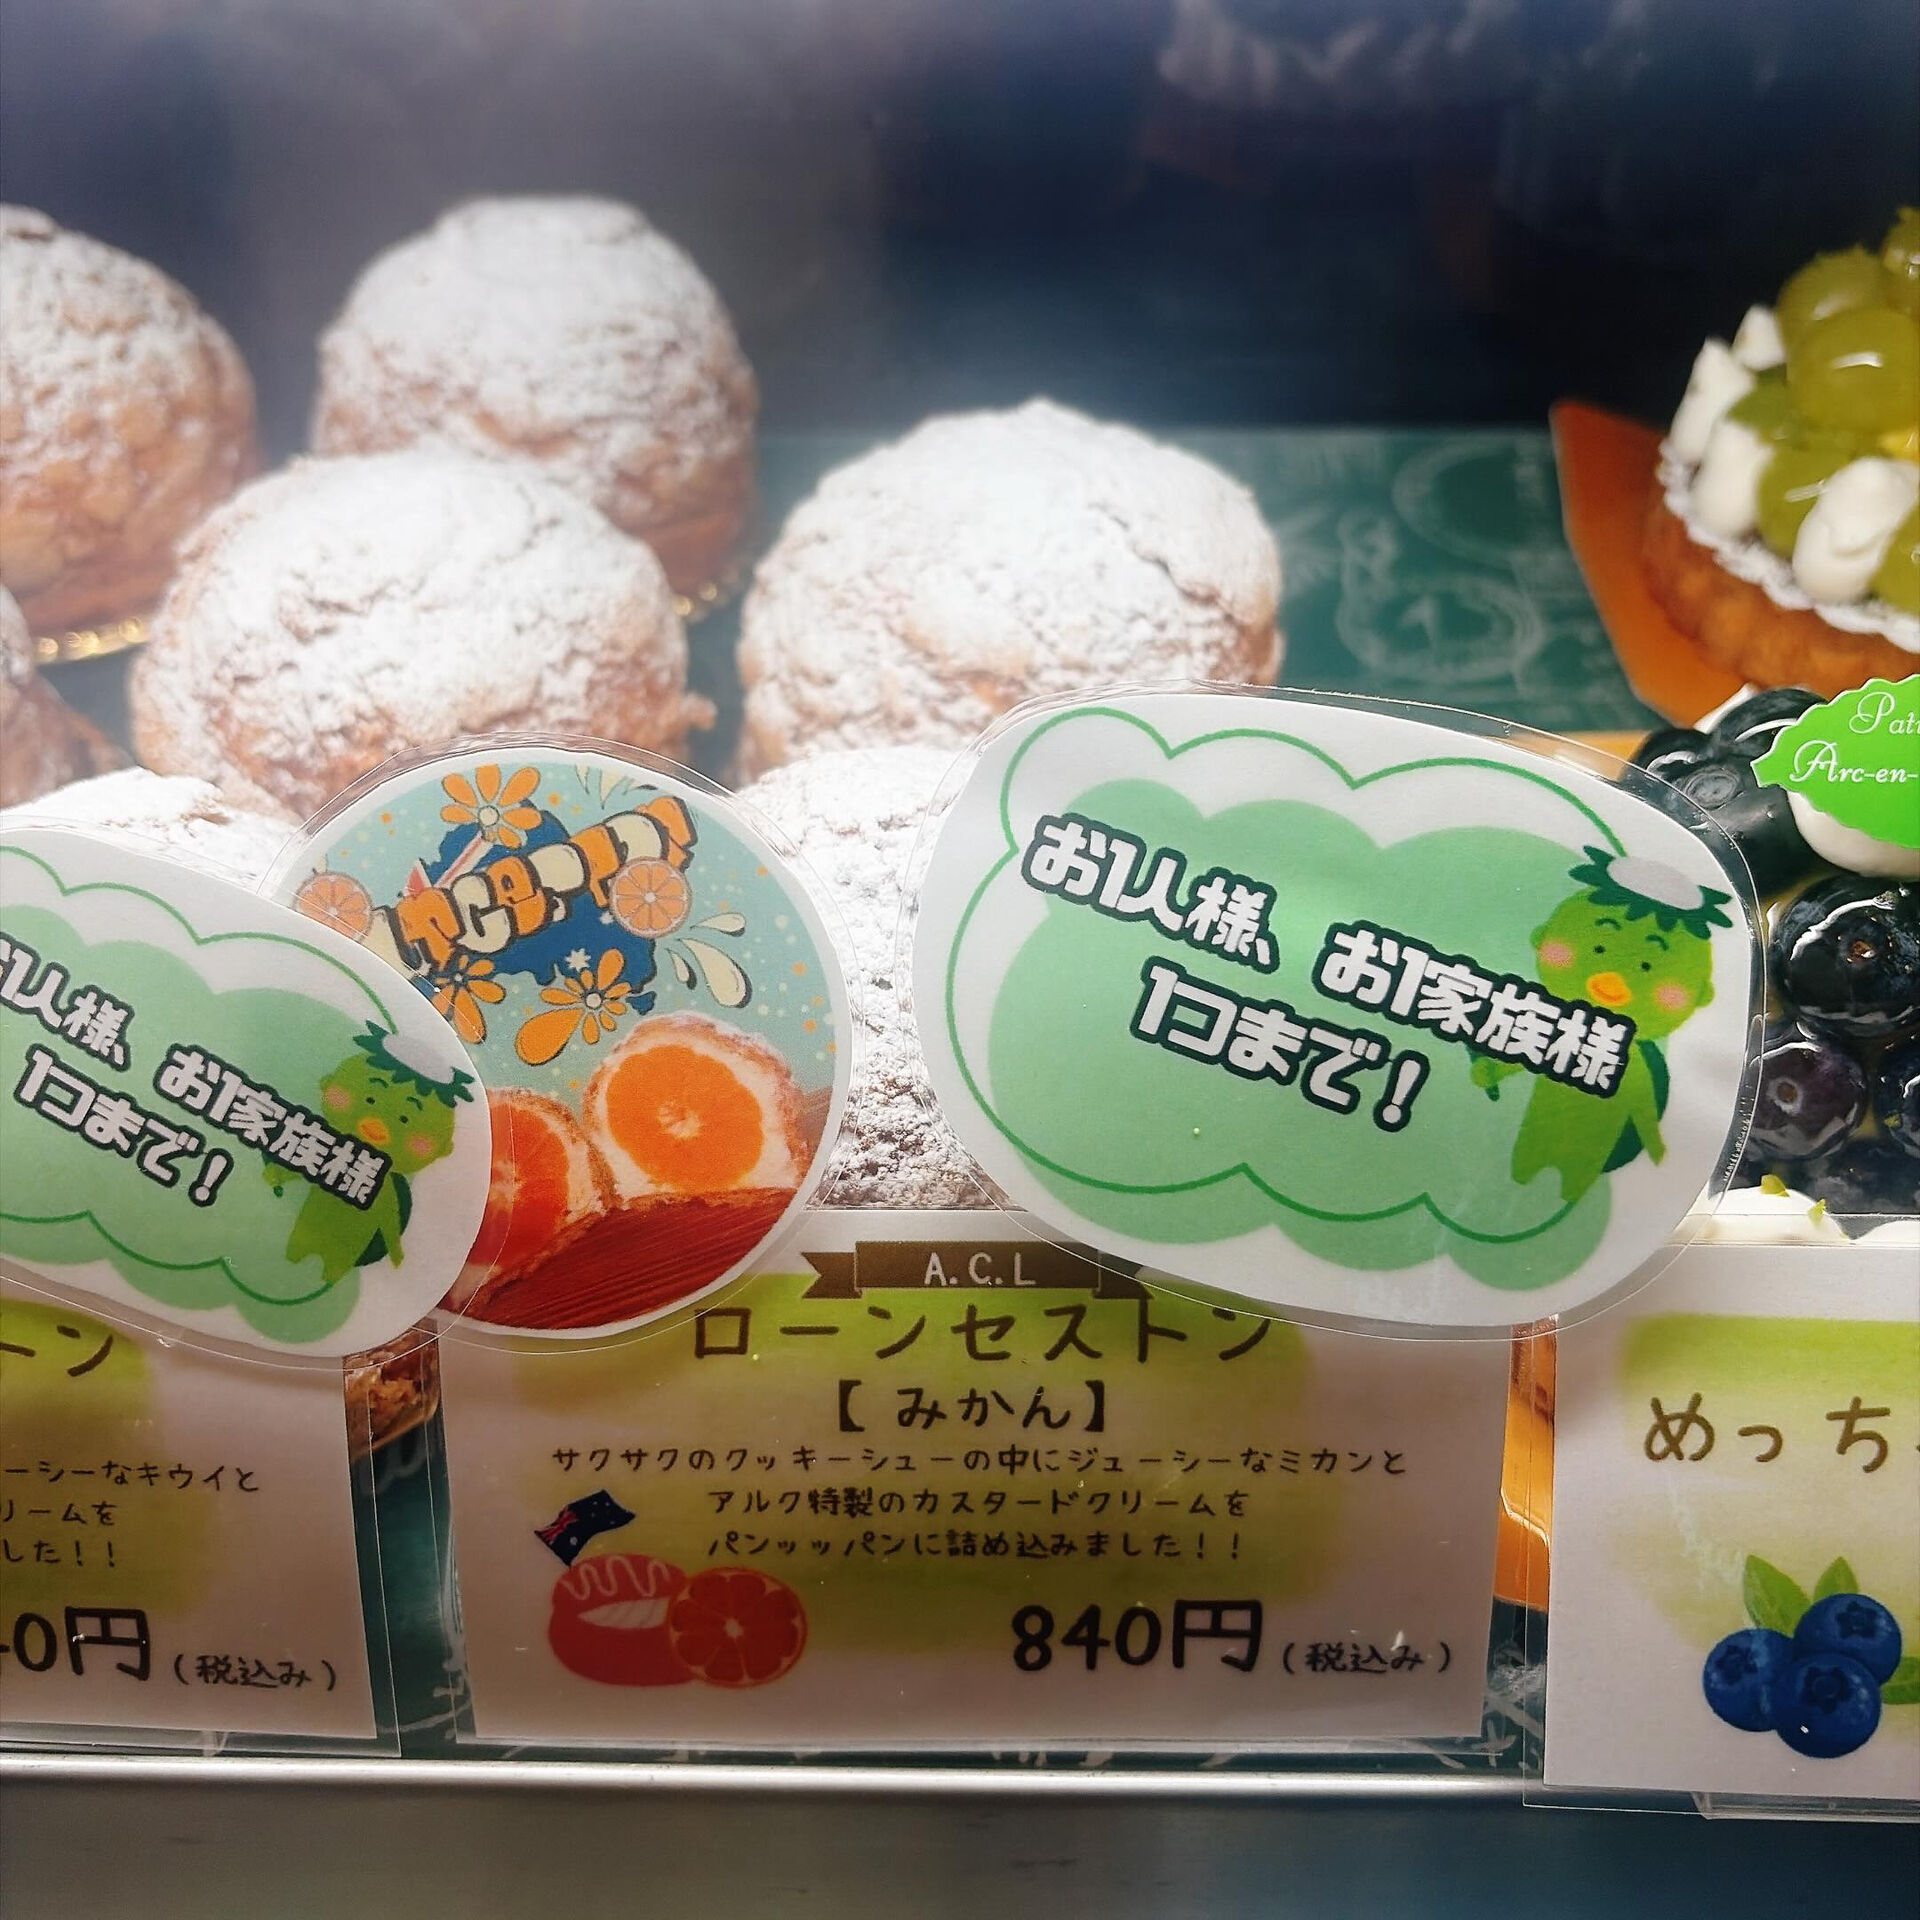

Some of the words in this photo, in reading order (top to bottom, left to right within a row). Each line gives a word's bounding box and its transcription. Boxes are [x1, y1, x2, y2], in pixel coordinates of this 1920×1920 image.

[1314, 921, 1635, 1096] お1家族様
[0, 932, 135, 1070] 1人様、
[154, 1044, 391, 1209] お1家族様
[922, 1252, 1036, 1287] A.C.L
[694, 1303, 1273, 1363] ローンセストン
[1644, 1394, 1920, 1473] めっち
[710, 1488, 1249, 1517] アルク特製のカスタードクリームを
[0, 1606, 151, 1681] 0円
[1011, 1600, 1263, 1672] 840円
